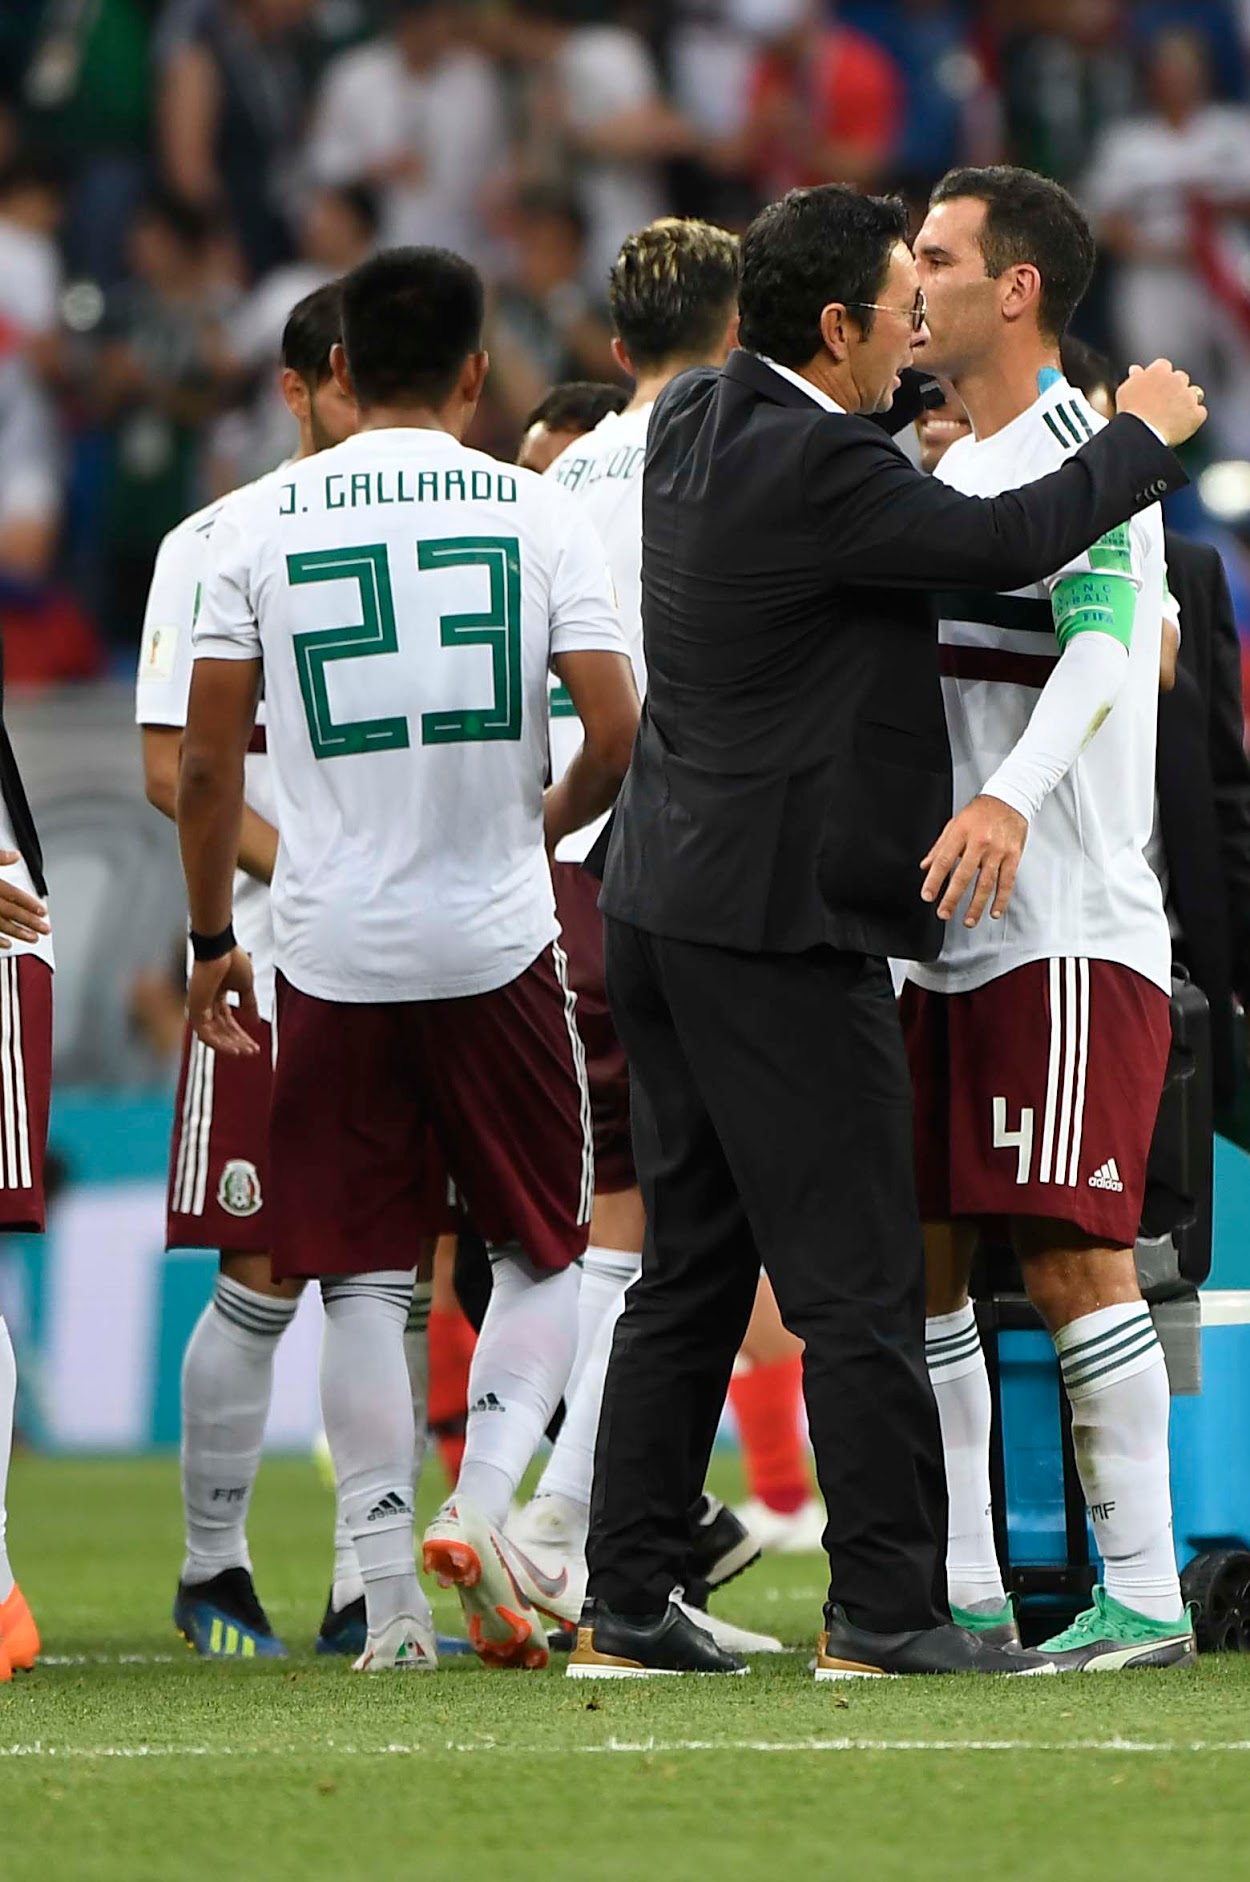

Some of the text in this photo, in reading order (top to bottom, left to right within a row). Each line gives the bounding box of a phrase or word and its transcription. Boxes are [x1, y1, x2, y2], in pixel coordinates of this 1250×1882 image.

[279, 470, 517, 515] J. GALLARDO
[286, 536, 521, 759] 23
[992, 1096, 1034, 1184] 4
[1088, 1176, 1124, 1193] adidas
[1087, 1501, 1116, 1523] MF
